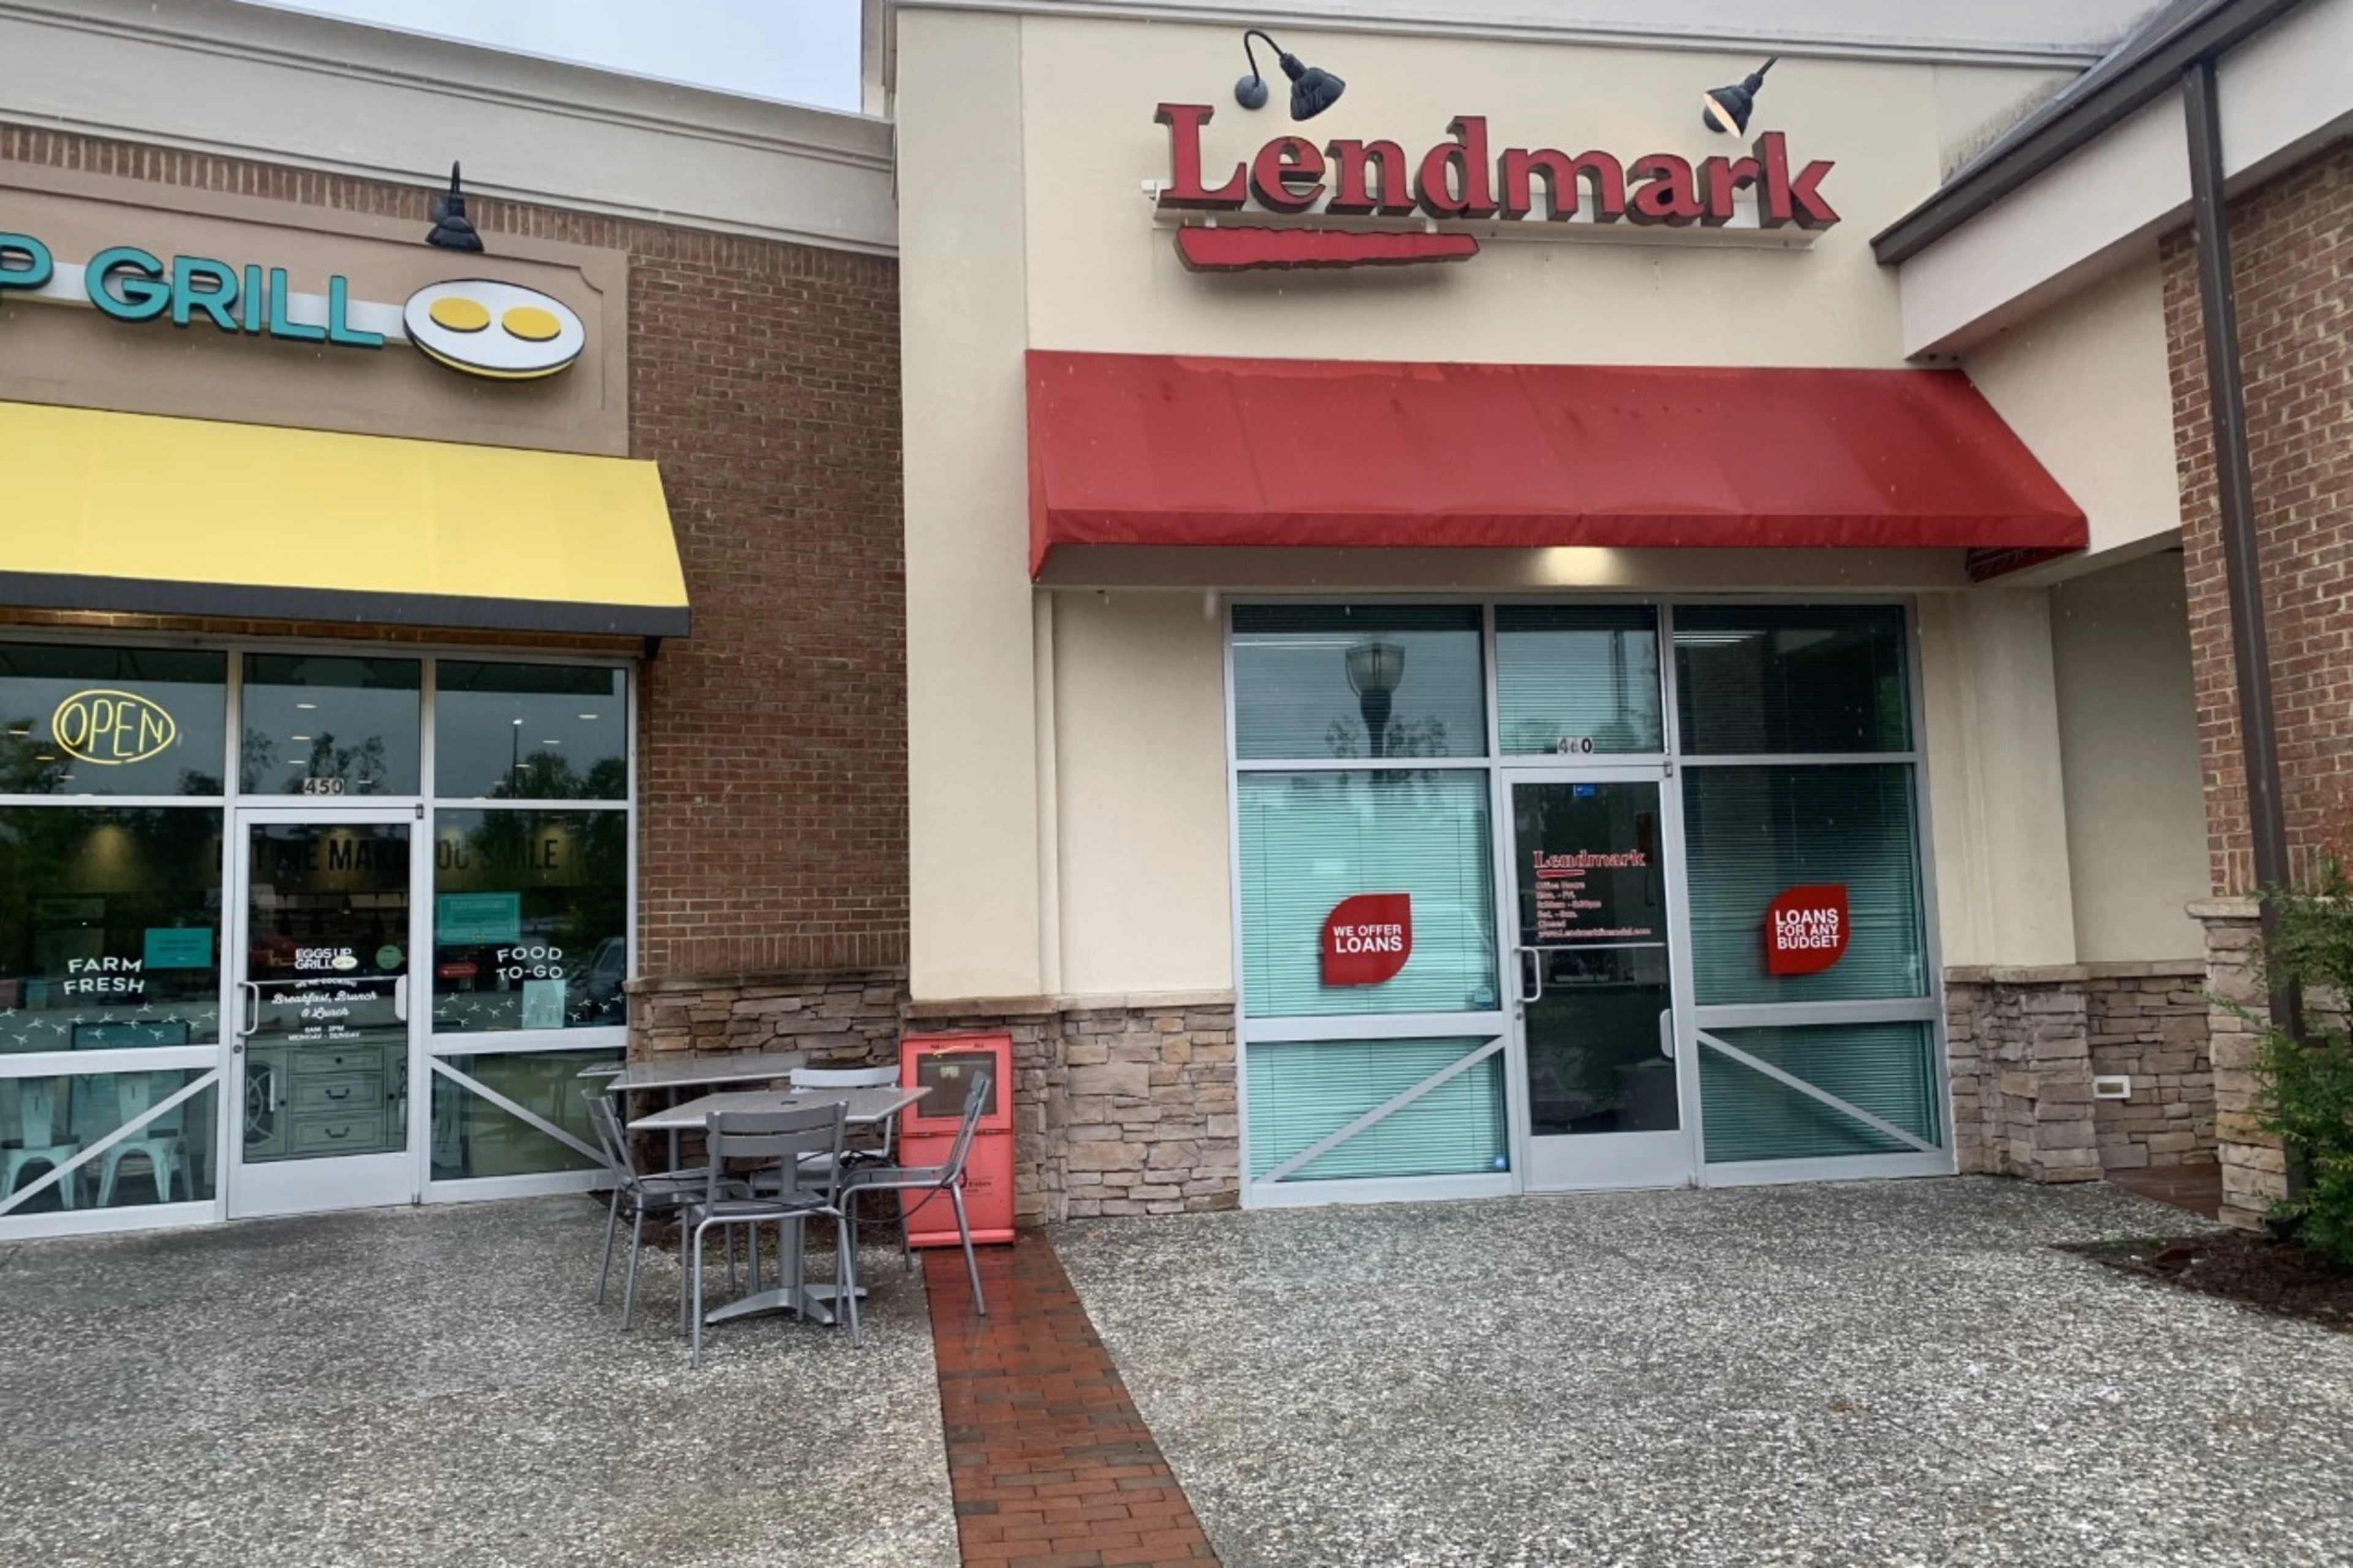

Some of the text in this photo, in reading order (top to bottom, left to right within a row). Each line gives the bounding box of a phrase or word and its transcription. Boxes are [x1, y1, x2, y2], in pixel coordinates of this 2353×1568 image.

[1153, 102, 1841, 230] Lendmark
[84, 246, 384, 349] GRILL
[60, 699, 163, 757] OPEN
[305, 779, 343, 795] 450
[1533, 849, 1646, 868] Lendmark
[1775, 908, 1839, 926] LOANS
[1333, 924, 1402, 937] WE OFFER
[1776, 923, 1839, 937] FOR ANY
[1335, 936, 1403, 953] LOANS
[1778, 935, 1840, 950] BUDGET
[295, 947, 352, 959] EGGS UP
[496, 945, 563, 963] FOOD
[67, 956, 143, 974] FARM
[295, 958, 333, 970] GRILL
[495, 964, 564, 982] TO-GO
[63, 977, 145, 996] FRESH
[334, 990, 378, 1002] Brunch
